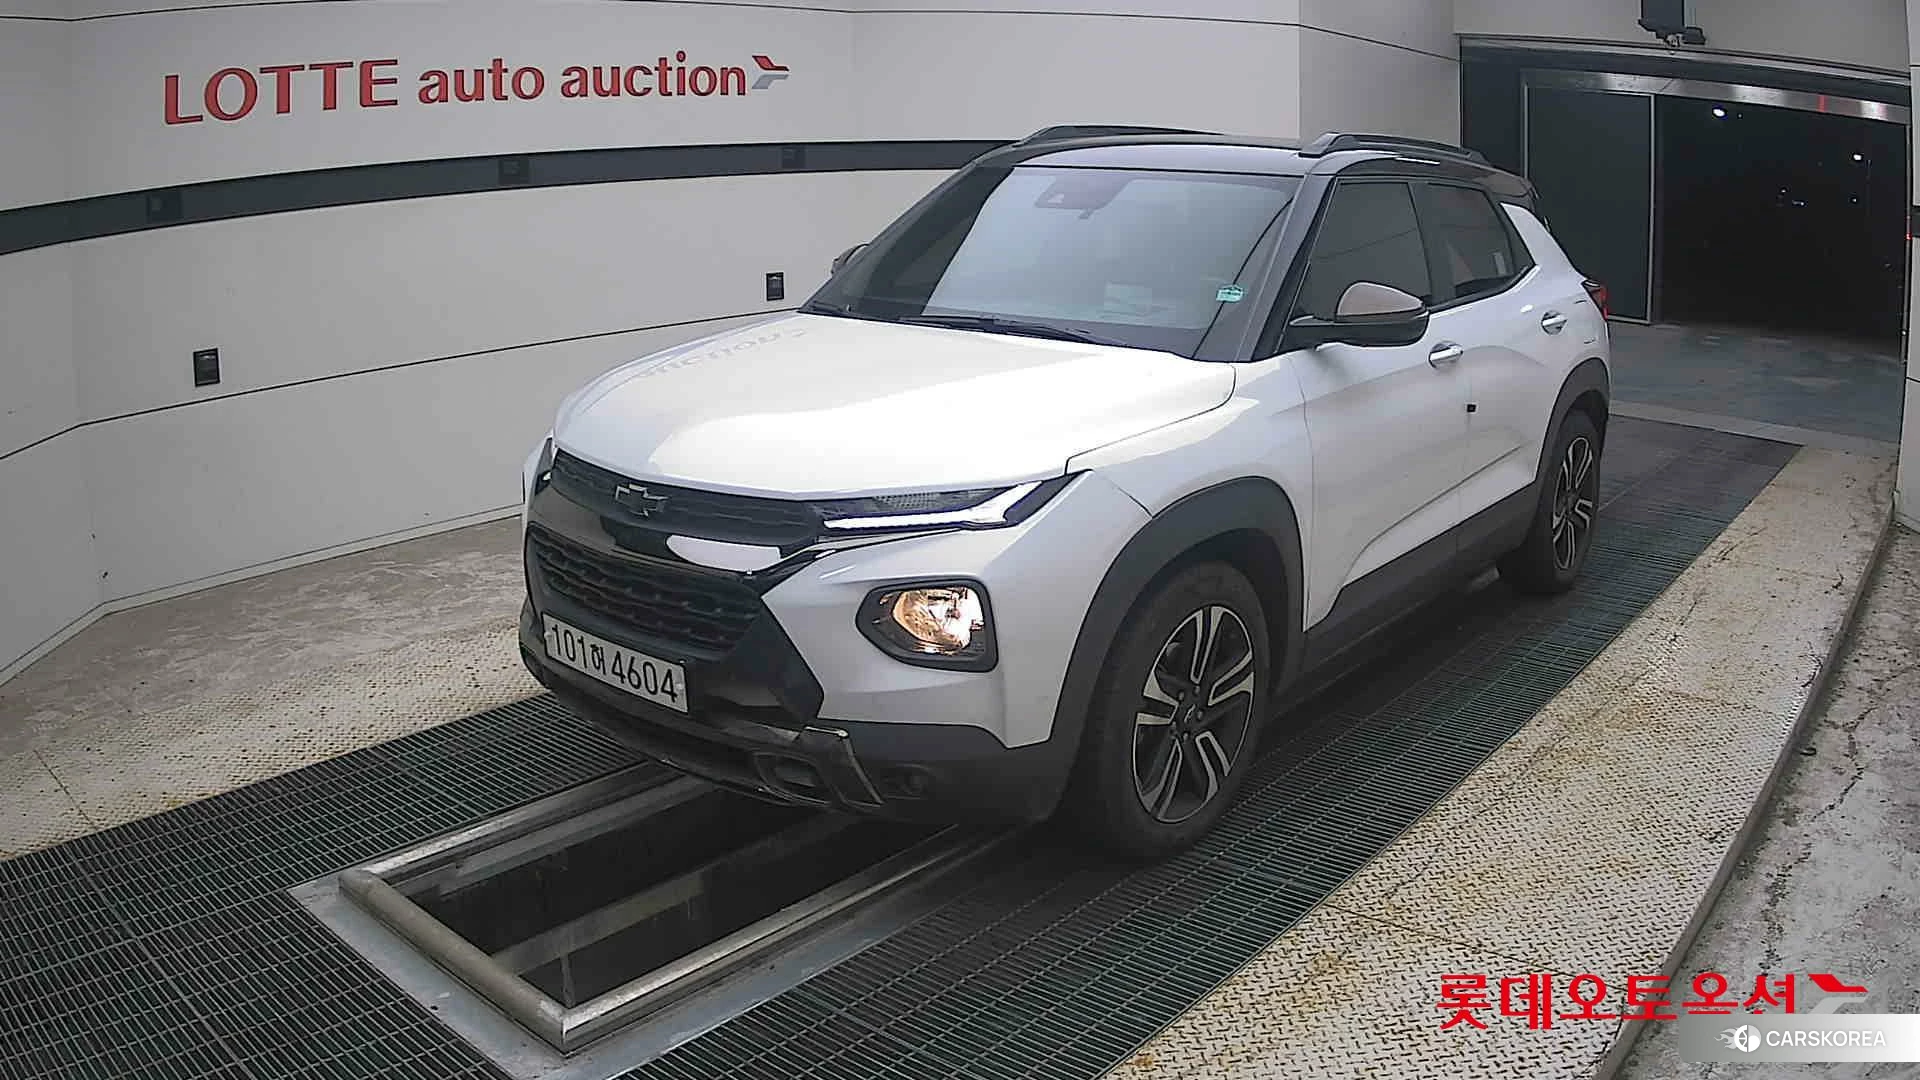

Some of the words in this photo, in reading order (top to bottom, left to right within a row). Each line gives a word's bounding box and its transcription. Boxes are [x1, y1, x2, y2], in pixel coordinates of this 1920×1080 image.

[163, 58, 398, 125] LOTTE
[418, 57, 546, 105] auto
[560, 50, 748, 98] auction
